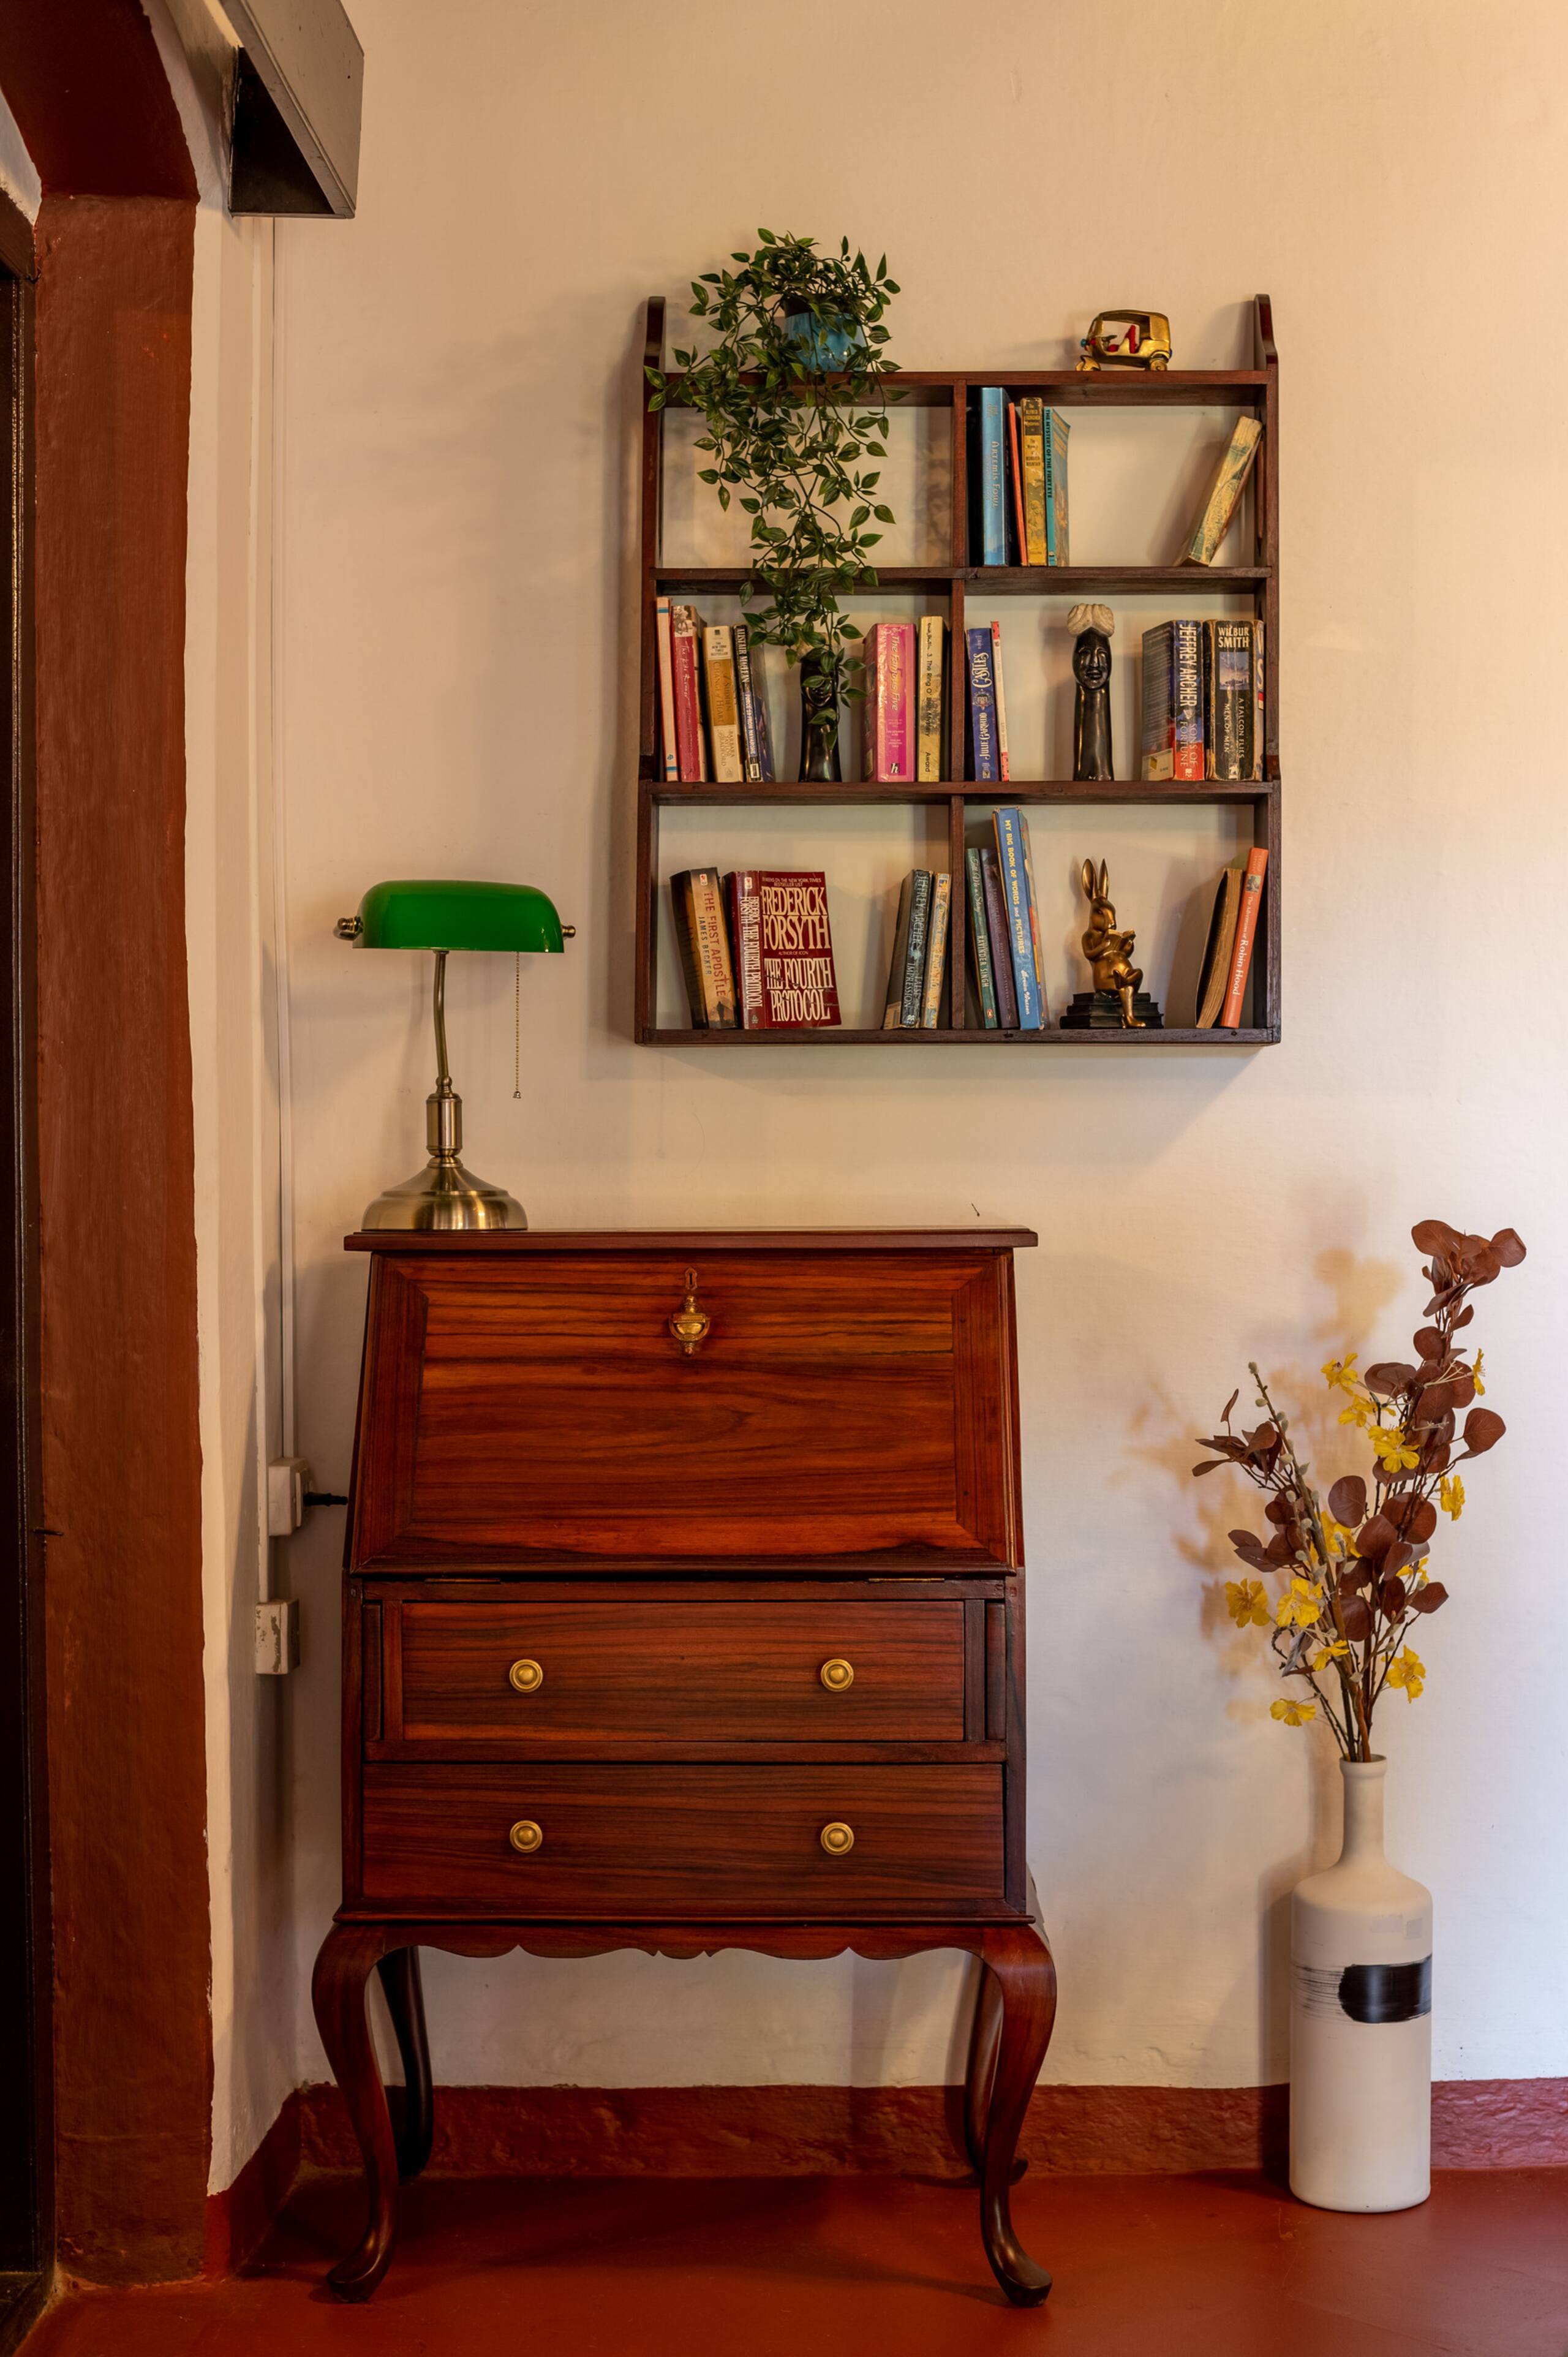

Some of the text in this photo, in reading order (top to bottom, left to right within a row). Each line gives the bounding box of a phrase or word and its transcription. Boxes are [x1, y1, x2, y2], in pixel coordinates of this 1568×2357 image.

[737, 628, 747, 654] ALISTAIR
[891, 636, 900, 652] The
[1218, 627, 1249, 637] WILBUR
[1218, 636, 1249, 648] SMITH
[891, 654, 900, 690] Famous
[972, 652, 992, 688] CASTLES
[1179, 624, 1197, 707] JEFFREY ARCHER
[891, 692, 900, 711] Five
[979, 712, 990, 740] GARWOOD
[979, 740, 990, 760] JULIE
[1180, 721, 1188, 767] FORTUNE
[1189, 752, 1197, 766] OF
[1005, 820, 1011, 831] MY
[1008, 847, 1016, 867] BOOK
[1010, 869, 1017, 878] OF
[761, 886, 827, 916] FREDERICK
[1011, 880, 1020, 905] WORDS
[740, 896, 751, 924] FORSYTH
[912, 875, 928, 945] JEFFREY ARCHER
[698, 916, 712, 975] JAMES BECKER
[704, 890, 729, 997] THE FIRST APOSTLE
[743, 926, 759, 941] THE
[763, 915, 831, 950] FORSYTH
[1016, 919, 1025, 954] PICTURES
[744, 941, 760, 971] FOURTH
[977, 935, 989, 987] RAVINDER SINGH
[1237, 939, 1249, 968] Robin
[764, 957, 834, 990] THE FOURTH
[903, 962, 916, 1009] IMPRESSION
[1232, 970, 1245, 995] Hood
[745, 971, 763, 1009] PROTOCOL
[770, 989, 831, 1022] PROTOCOL
